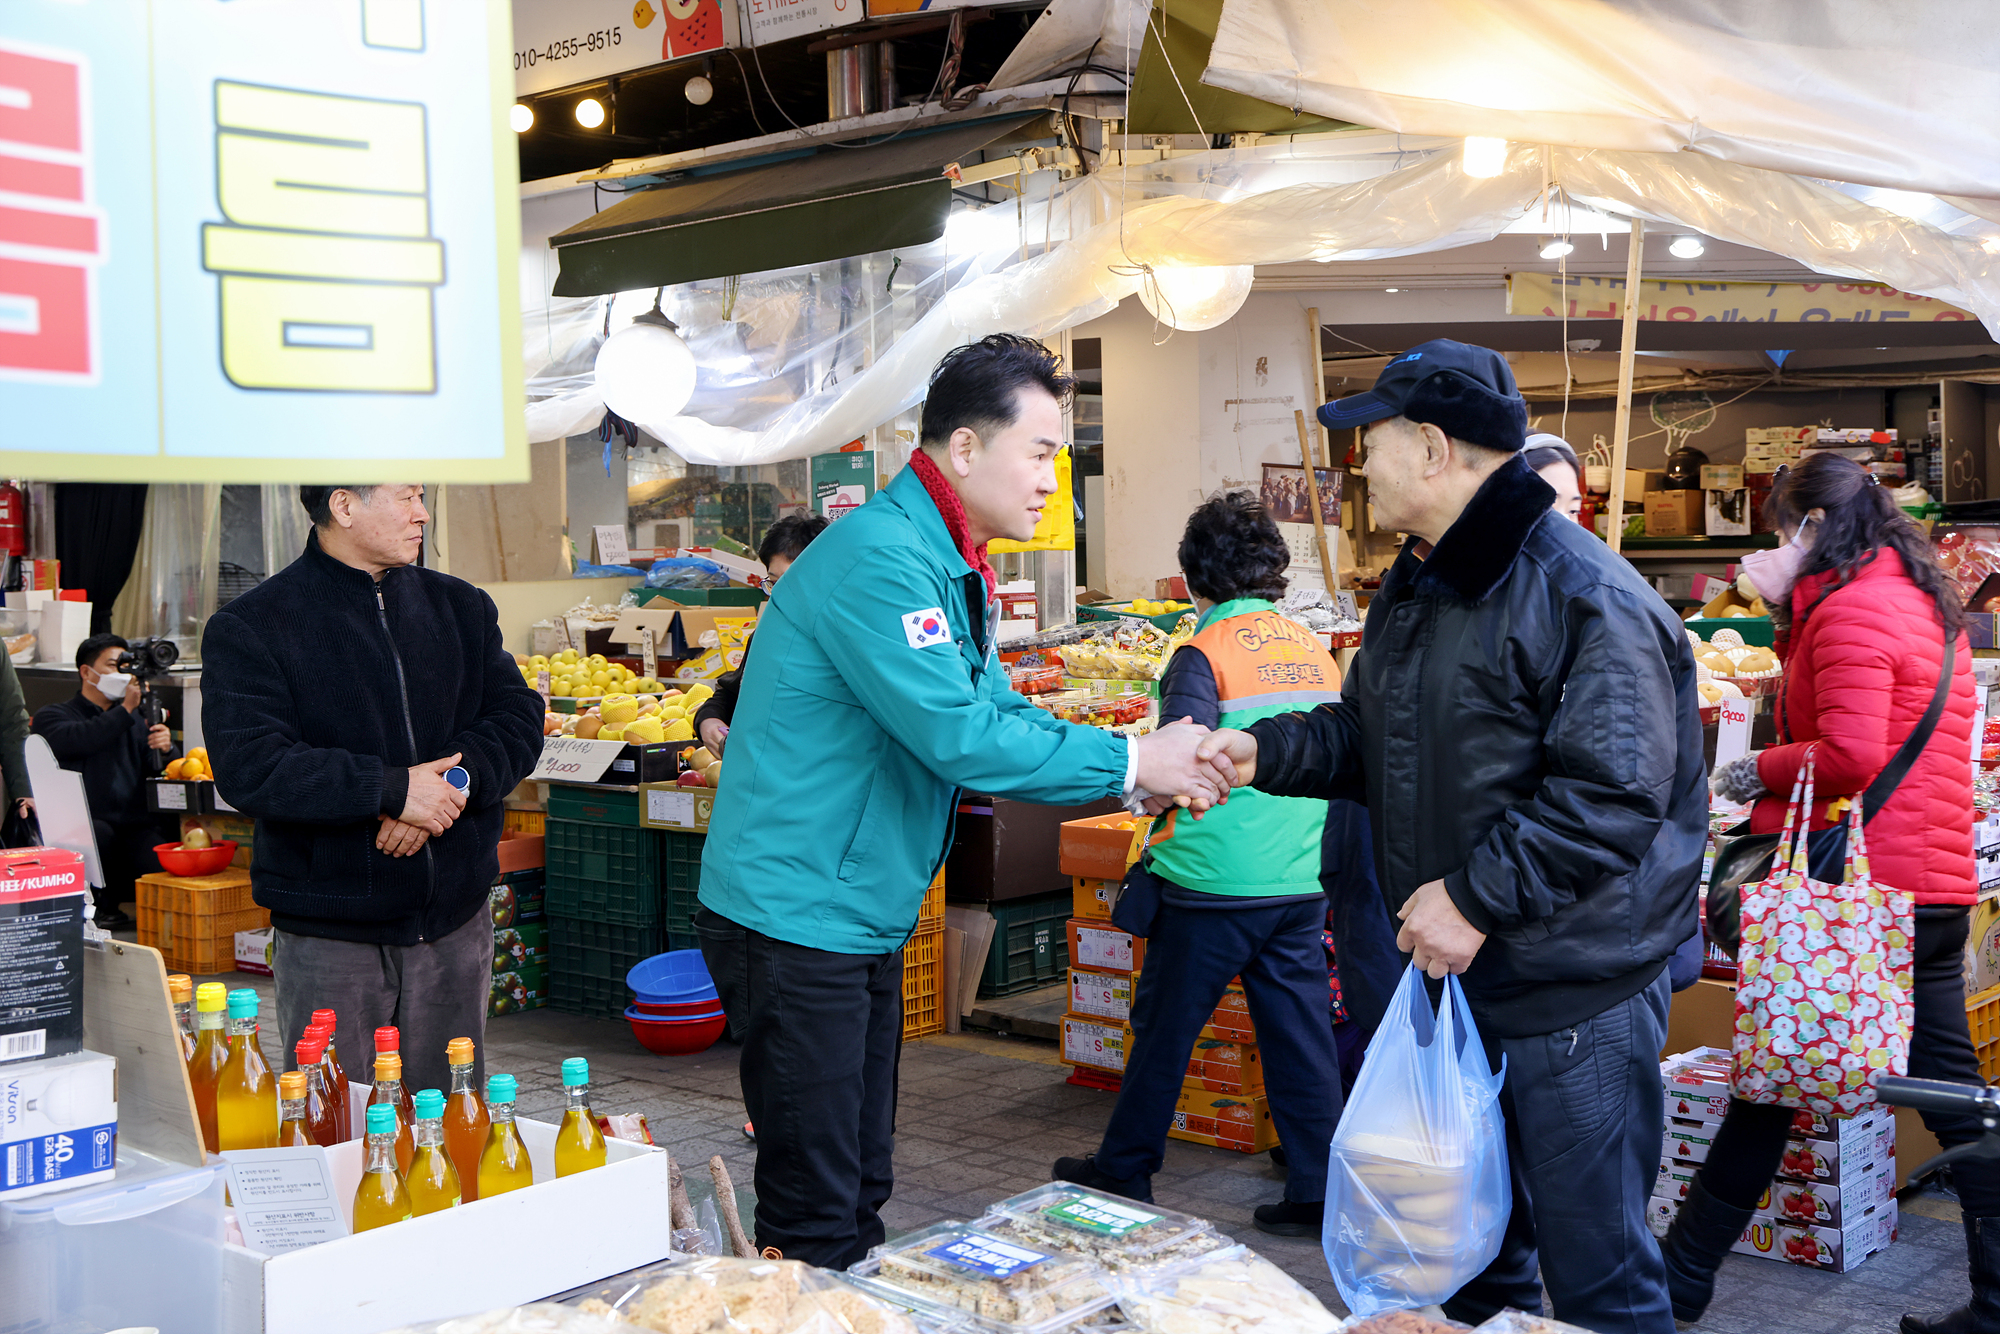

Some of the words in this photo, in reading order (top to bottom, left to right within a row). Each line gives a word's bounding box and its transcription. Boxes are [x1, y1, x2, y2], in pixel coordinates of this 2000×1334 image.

[755, 19, 771, 29] 고객과
[772, 14, 794, 26] 함께하는
[795, 6, 818, 20] 전통시장
[513, 26, 622, 71] 010-4255-9515
[201, 0, 447, 396] 름
[1266, 645, 1306, 661] 도봉구
[1102, 990, 1112, 1004] S
[1094, 1040, 1102, 1052] S
[1188, 1119, 1220, 1135] 효돈감귤
[44, 1136, 54, 1155] E26
[54, 1134, 74, 1162] 40
[44, 1156, 54, 1180] BASE
